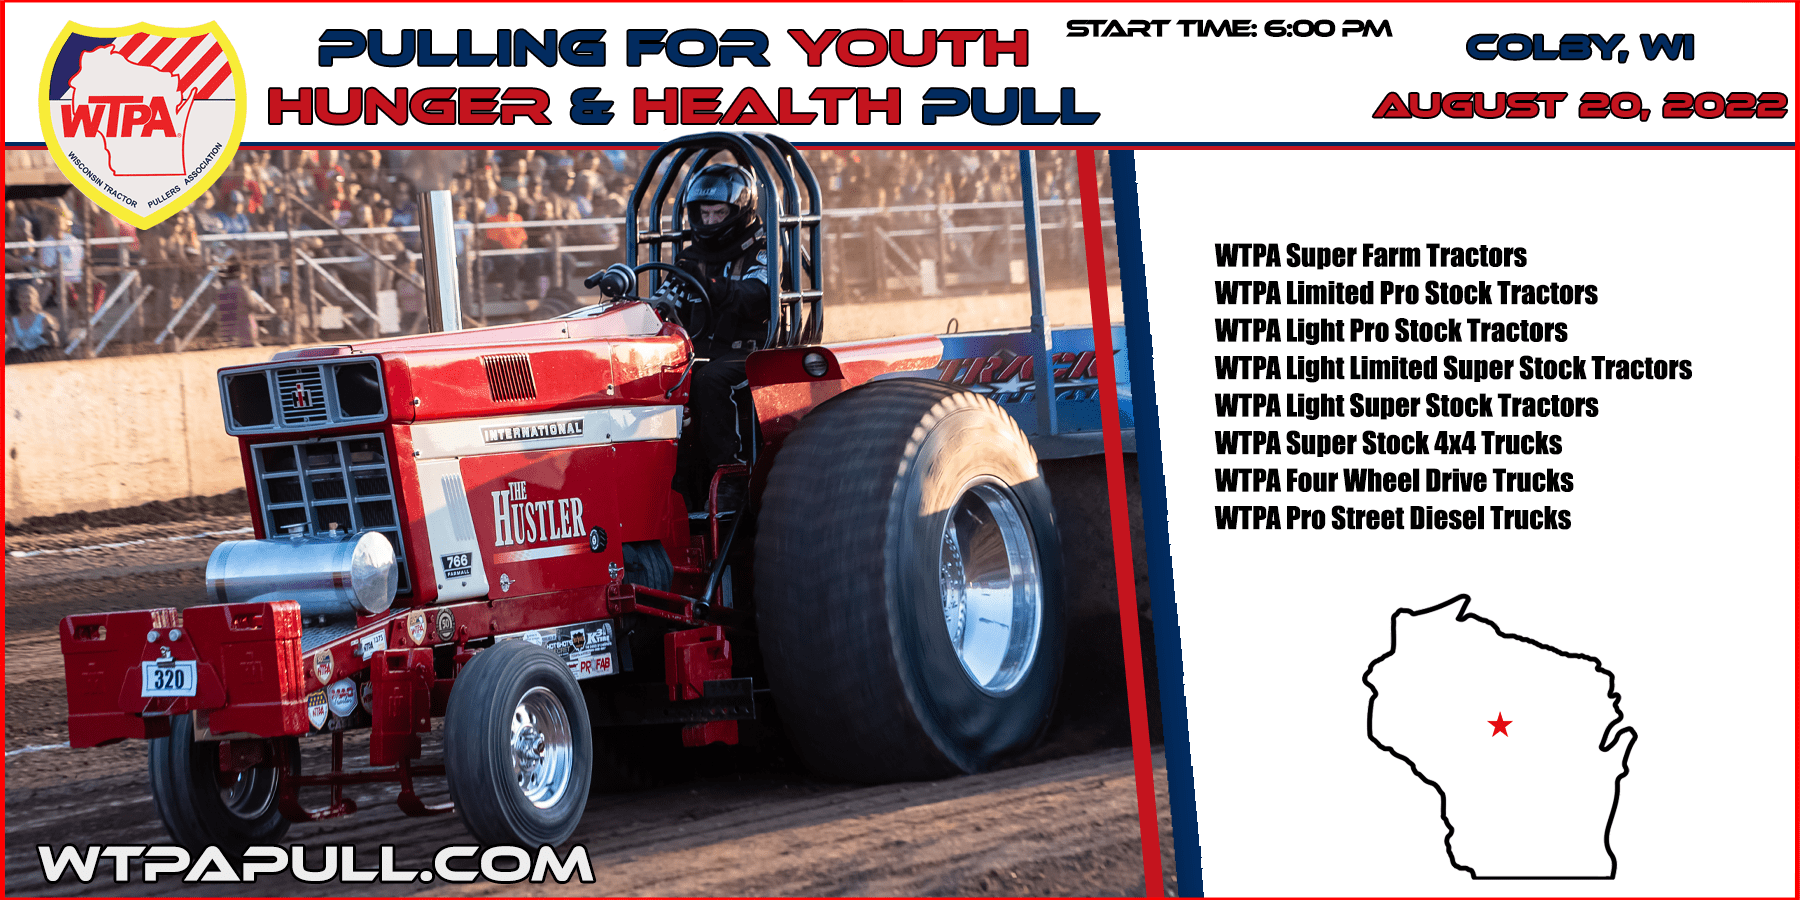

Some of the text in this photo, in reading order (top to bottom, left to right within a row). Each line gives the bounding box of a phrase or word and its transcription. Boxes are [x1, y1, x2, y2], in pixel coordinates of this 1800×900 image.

[484, 422, 582, 442] INTERNATIONAL
[508, 480, 528, 501] THE
[491, 489, 587, 547] HUSTLER
[447, 554, 468, 569] 766
[447, 569, 470, 577] FARMALL
[154, 669, 185, 690] 320
